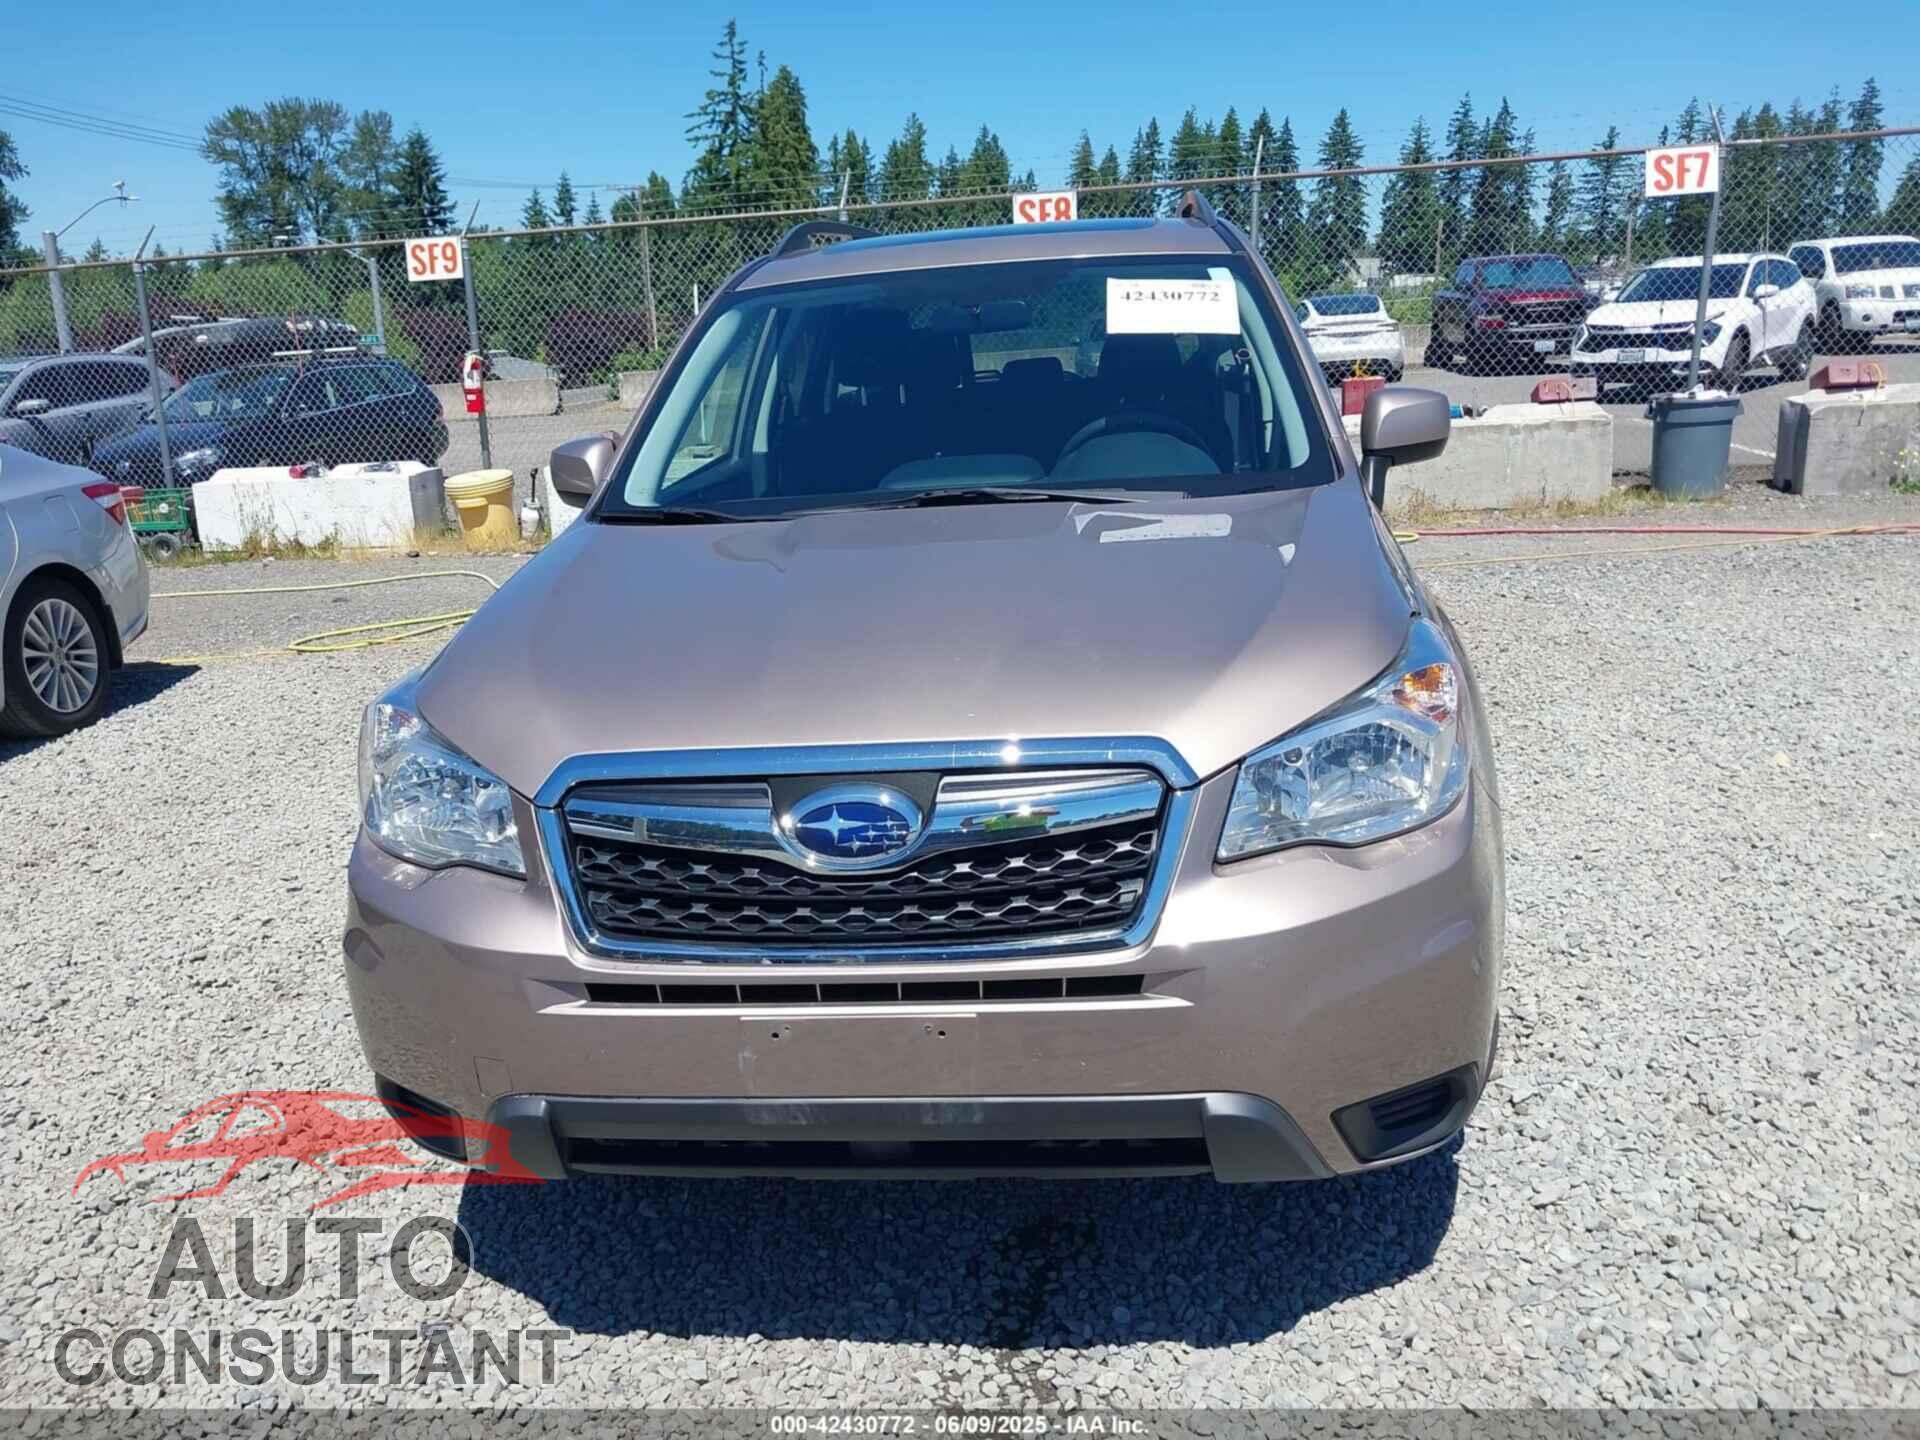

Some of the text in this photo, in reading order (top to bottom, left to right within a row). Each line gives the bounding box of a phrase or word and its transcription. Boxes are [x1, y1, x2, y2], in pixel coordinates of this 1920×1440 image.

[1654, 152, 1710, 191] SF7
[411, 241, 458, 275] SF9
[1119, 291, 1221, 302] 42430772
